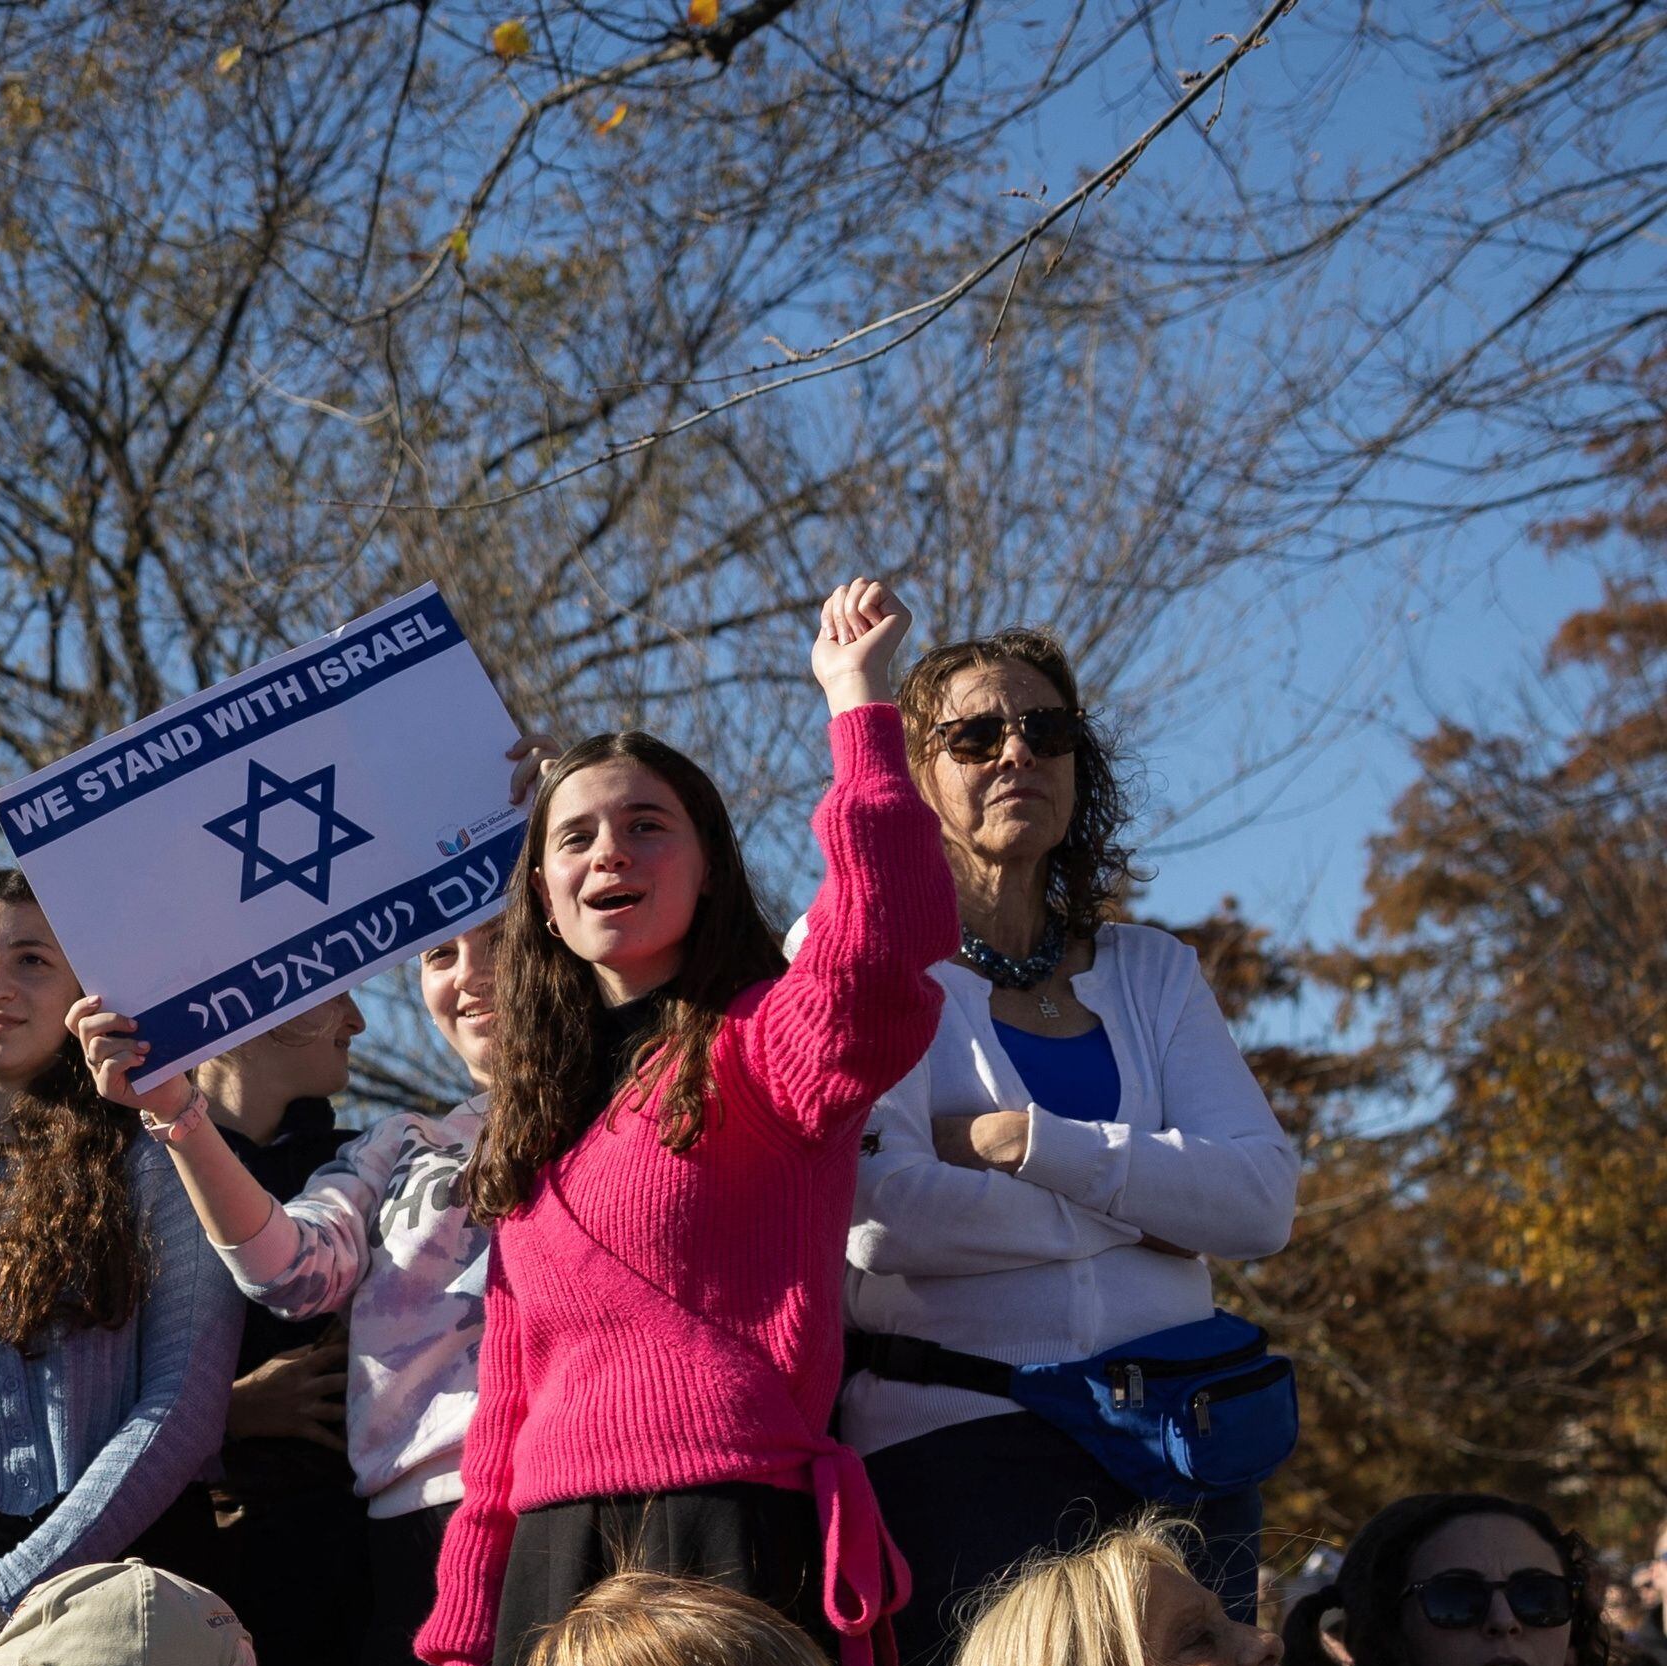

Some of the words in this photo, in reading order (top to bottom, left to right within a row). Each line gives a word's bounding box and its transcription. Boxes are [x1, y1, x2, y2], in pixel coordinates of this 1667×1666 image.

[7, 786, 74, 836] WE
[76, 723, 203, 802] STAND
[203, 675, 308, 739] WITH
[308, 611, 447, 693] ISRAEL
[469, 822, 489, 836] Beth
[428, 855, 500, 918] עם
[252, 899, 416, 1006] ישראל
[188, 987, 253, 1031] חי
